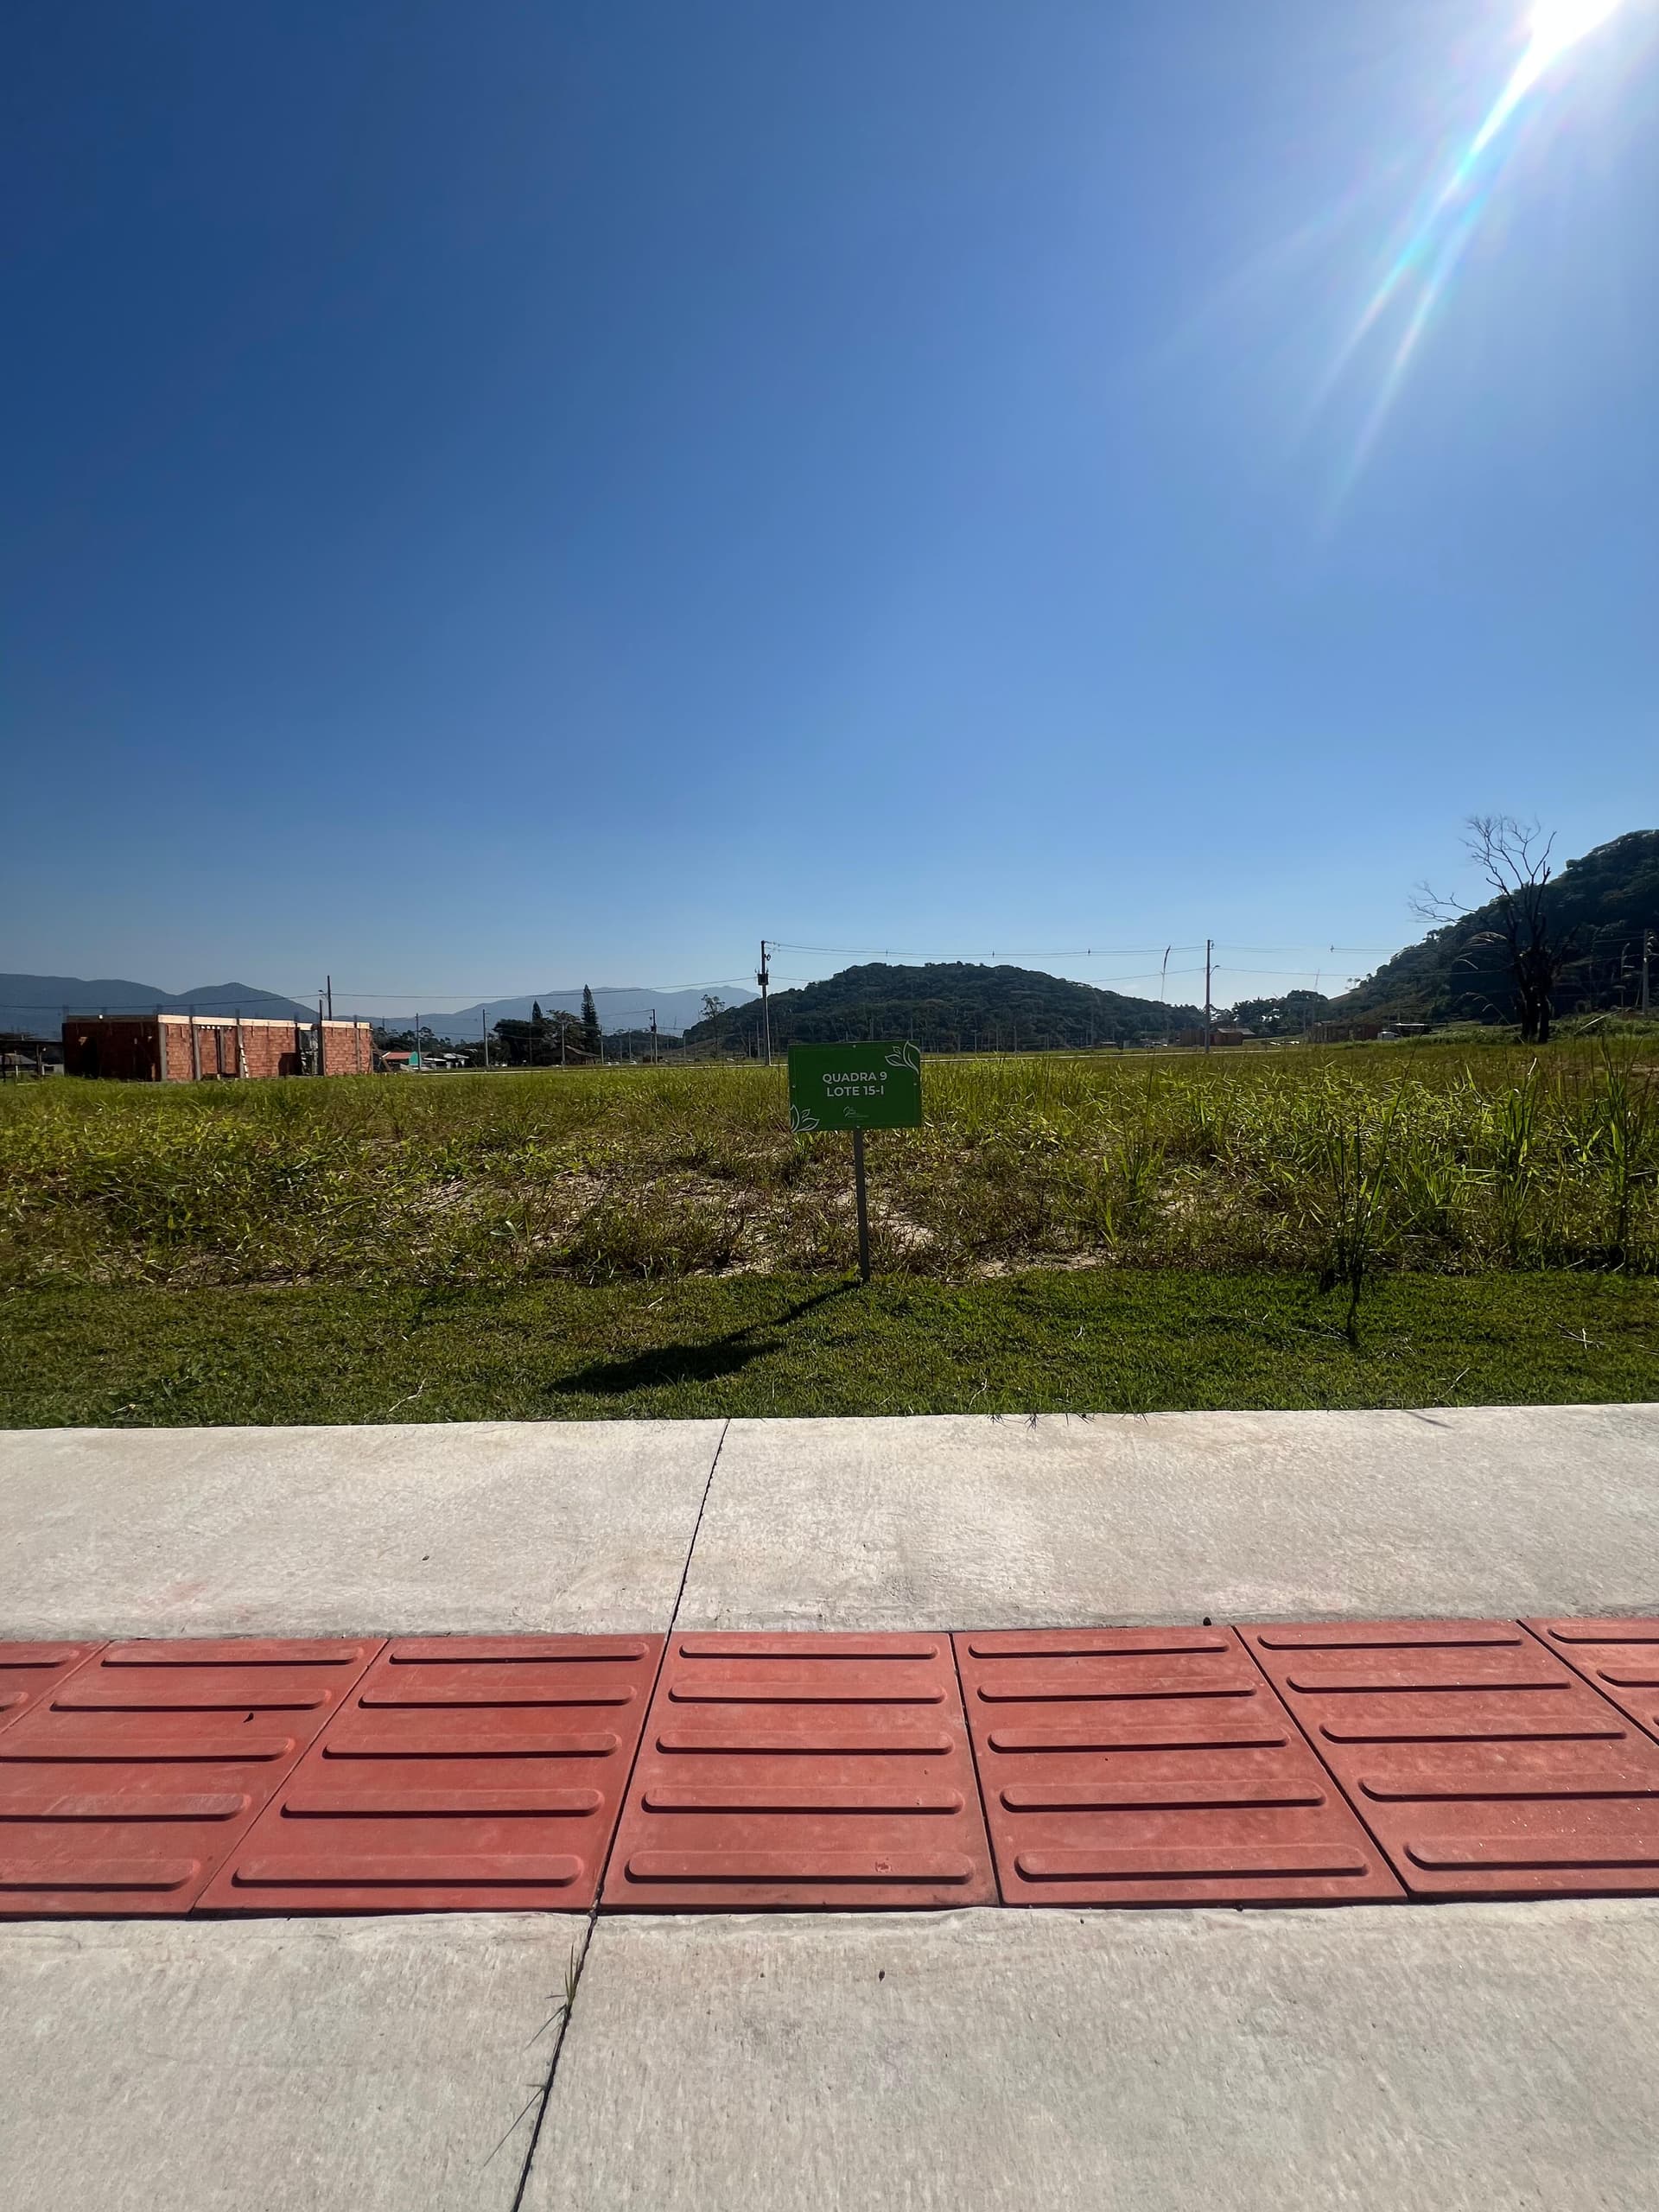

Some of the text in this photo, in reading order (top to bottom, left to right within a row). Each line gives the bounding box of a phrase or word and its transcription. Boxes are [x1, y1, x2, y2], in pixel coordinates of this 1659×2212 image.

[822, 1071, 887, 1084] QUADRA 9
[826, 1086, 861, 1097] LOTE
